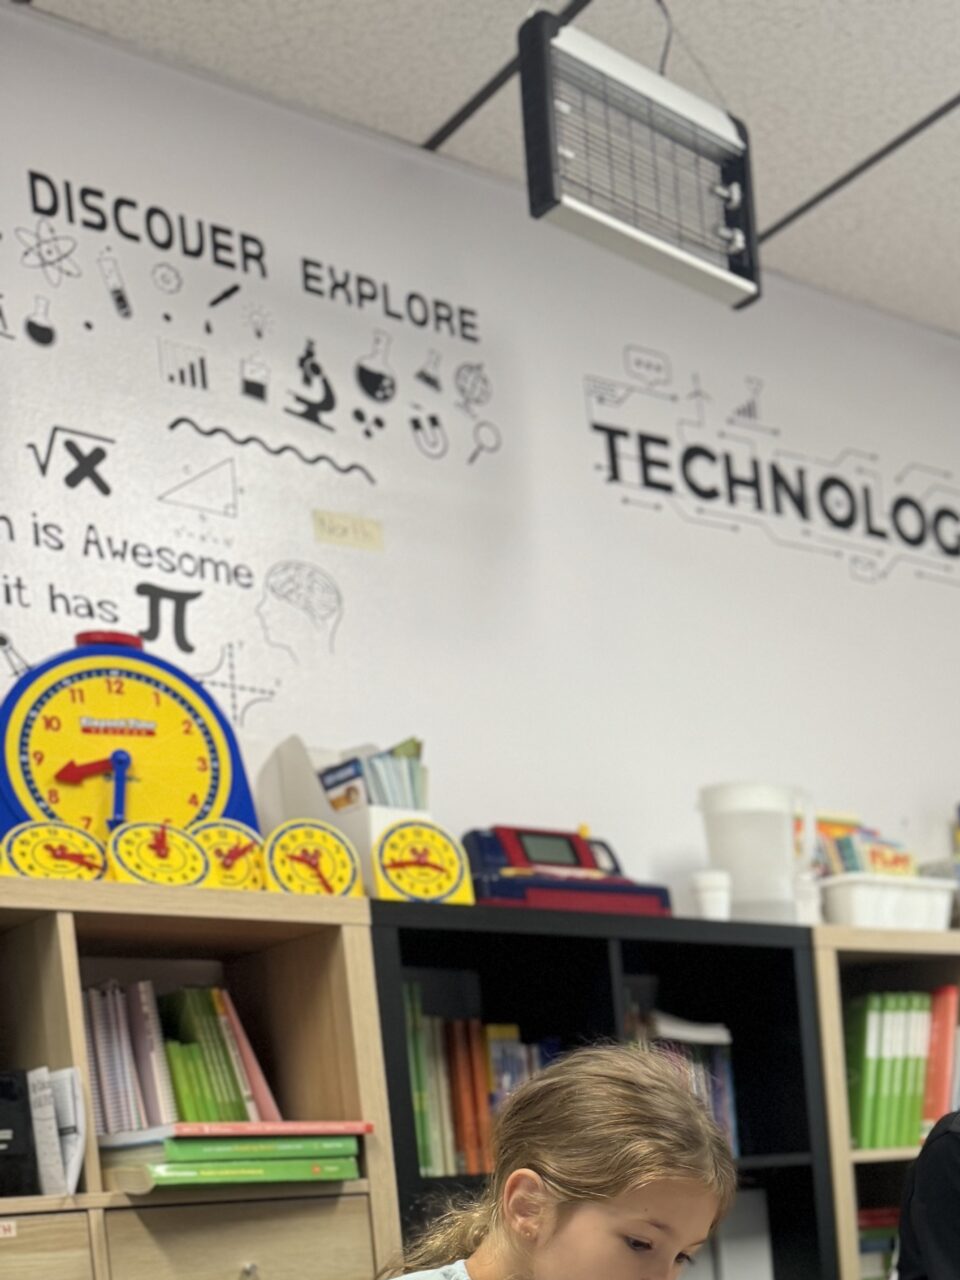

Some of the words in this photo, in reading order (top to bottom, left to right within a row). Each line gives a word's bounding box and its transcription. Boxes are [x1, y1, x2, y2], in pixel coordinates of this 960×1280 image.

[26, 168, 268, 278] DISCOVER
[301, 257, 481, 344] EXPLORE
[32, 512, 65, 551] is
[82, 523, 255, 590] Awesome
[1, 575, 31, 609] it
[48, 583, 120, 624] has
[105, 678, 125, 695] 12
[69, 687, 85, 704] 11
[152, 691, 161, 707] 1
[42, 715, 61, 732] 10
[182, 720, 194, 736] 2
[32, 750, 45, 767] 9
[197, 757, 208, 773] 3
[48, 789, 60, 805] 8
[187, 793, 199, 808] 4
[80, 816, 93, 831] 7
